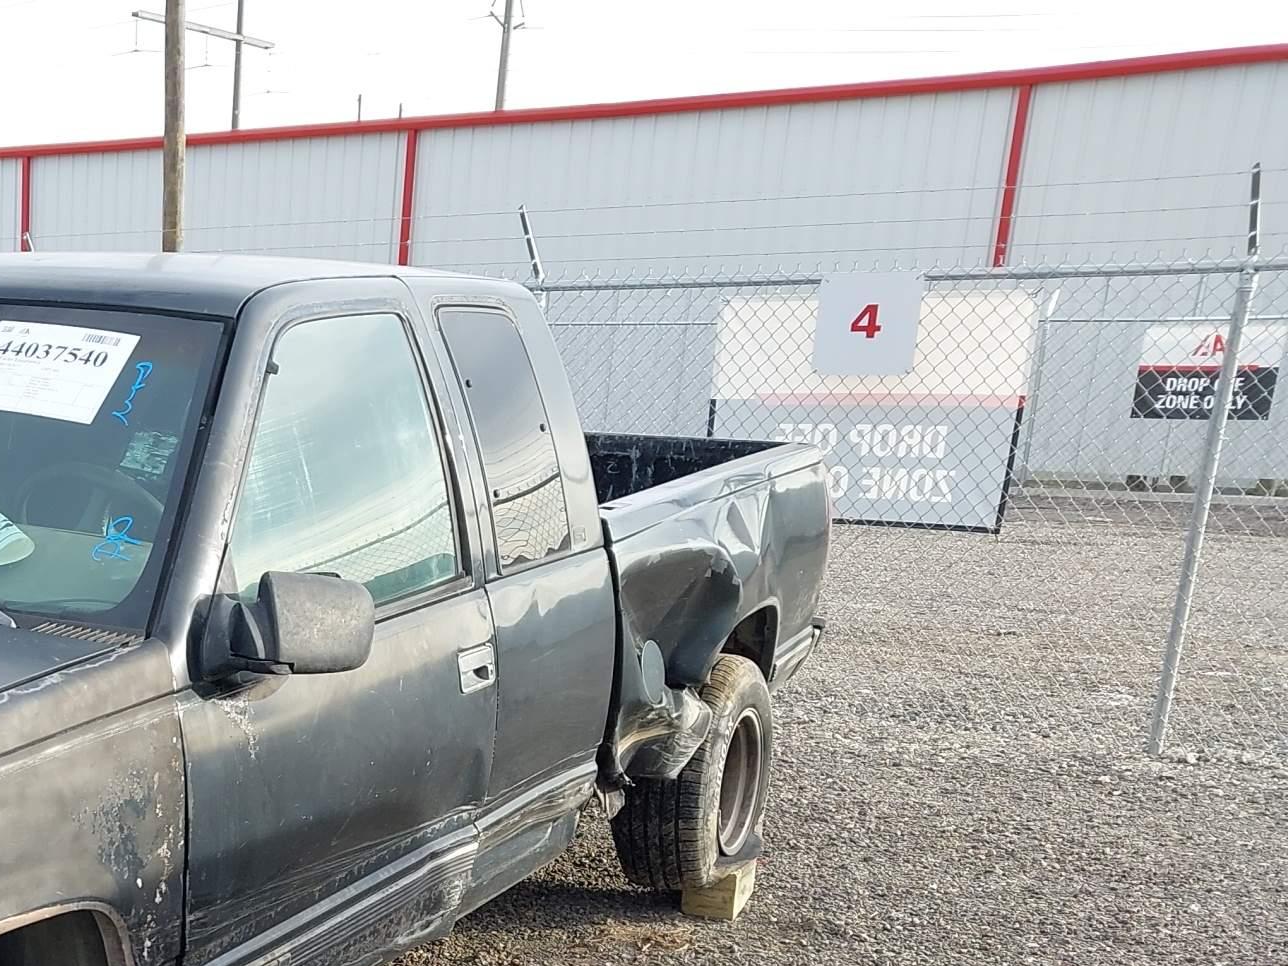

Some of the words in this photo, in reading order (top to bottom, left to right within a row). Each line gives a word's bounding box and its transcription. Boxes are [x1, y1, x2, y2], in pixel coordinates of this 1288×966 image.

[850, 303, 881, 339] 4
[1165, 377, 1211, 392] DROP
[1155, 394, 1200, 409] ZONE
[1203, 394, 1248, 409] OLY
